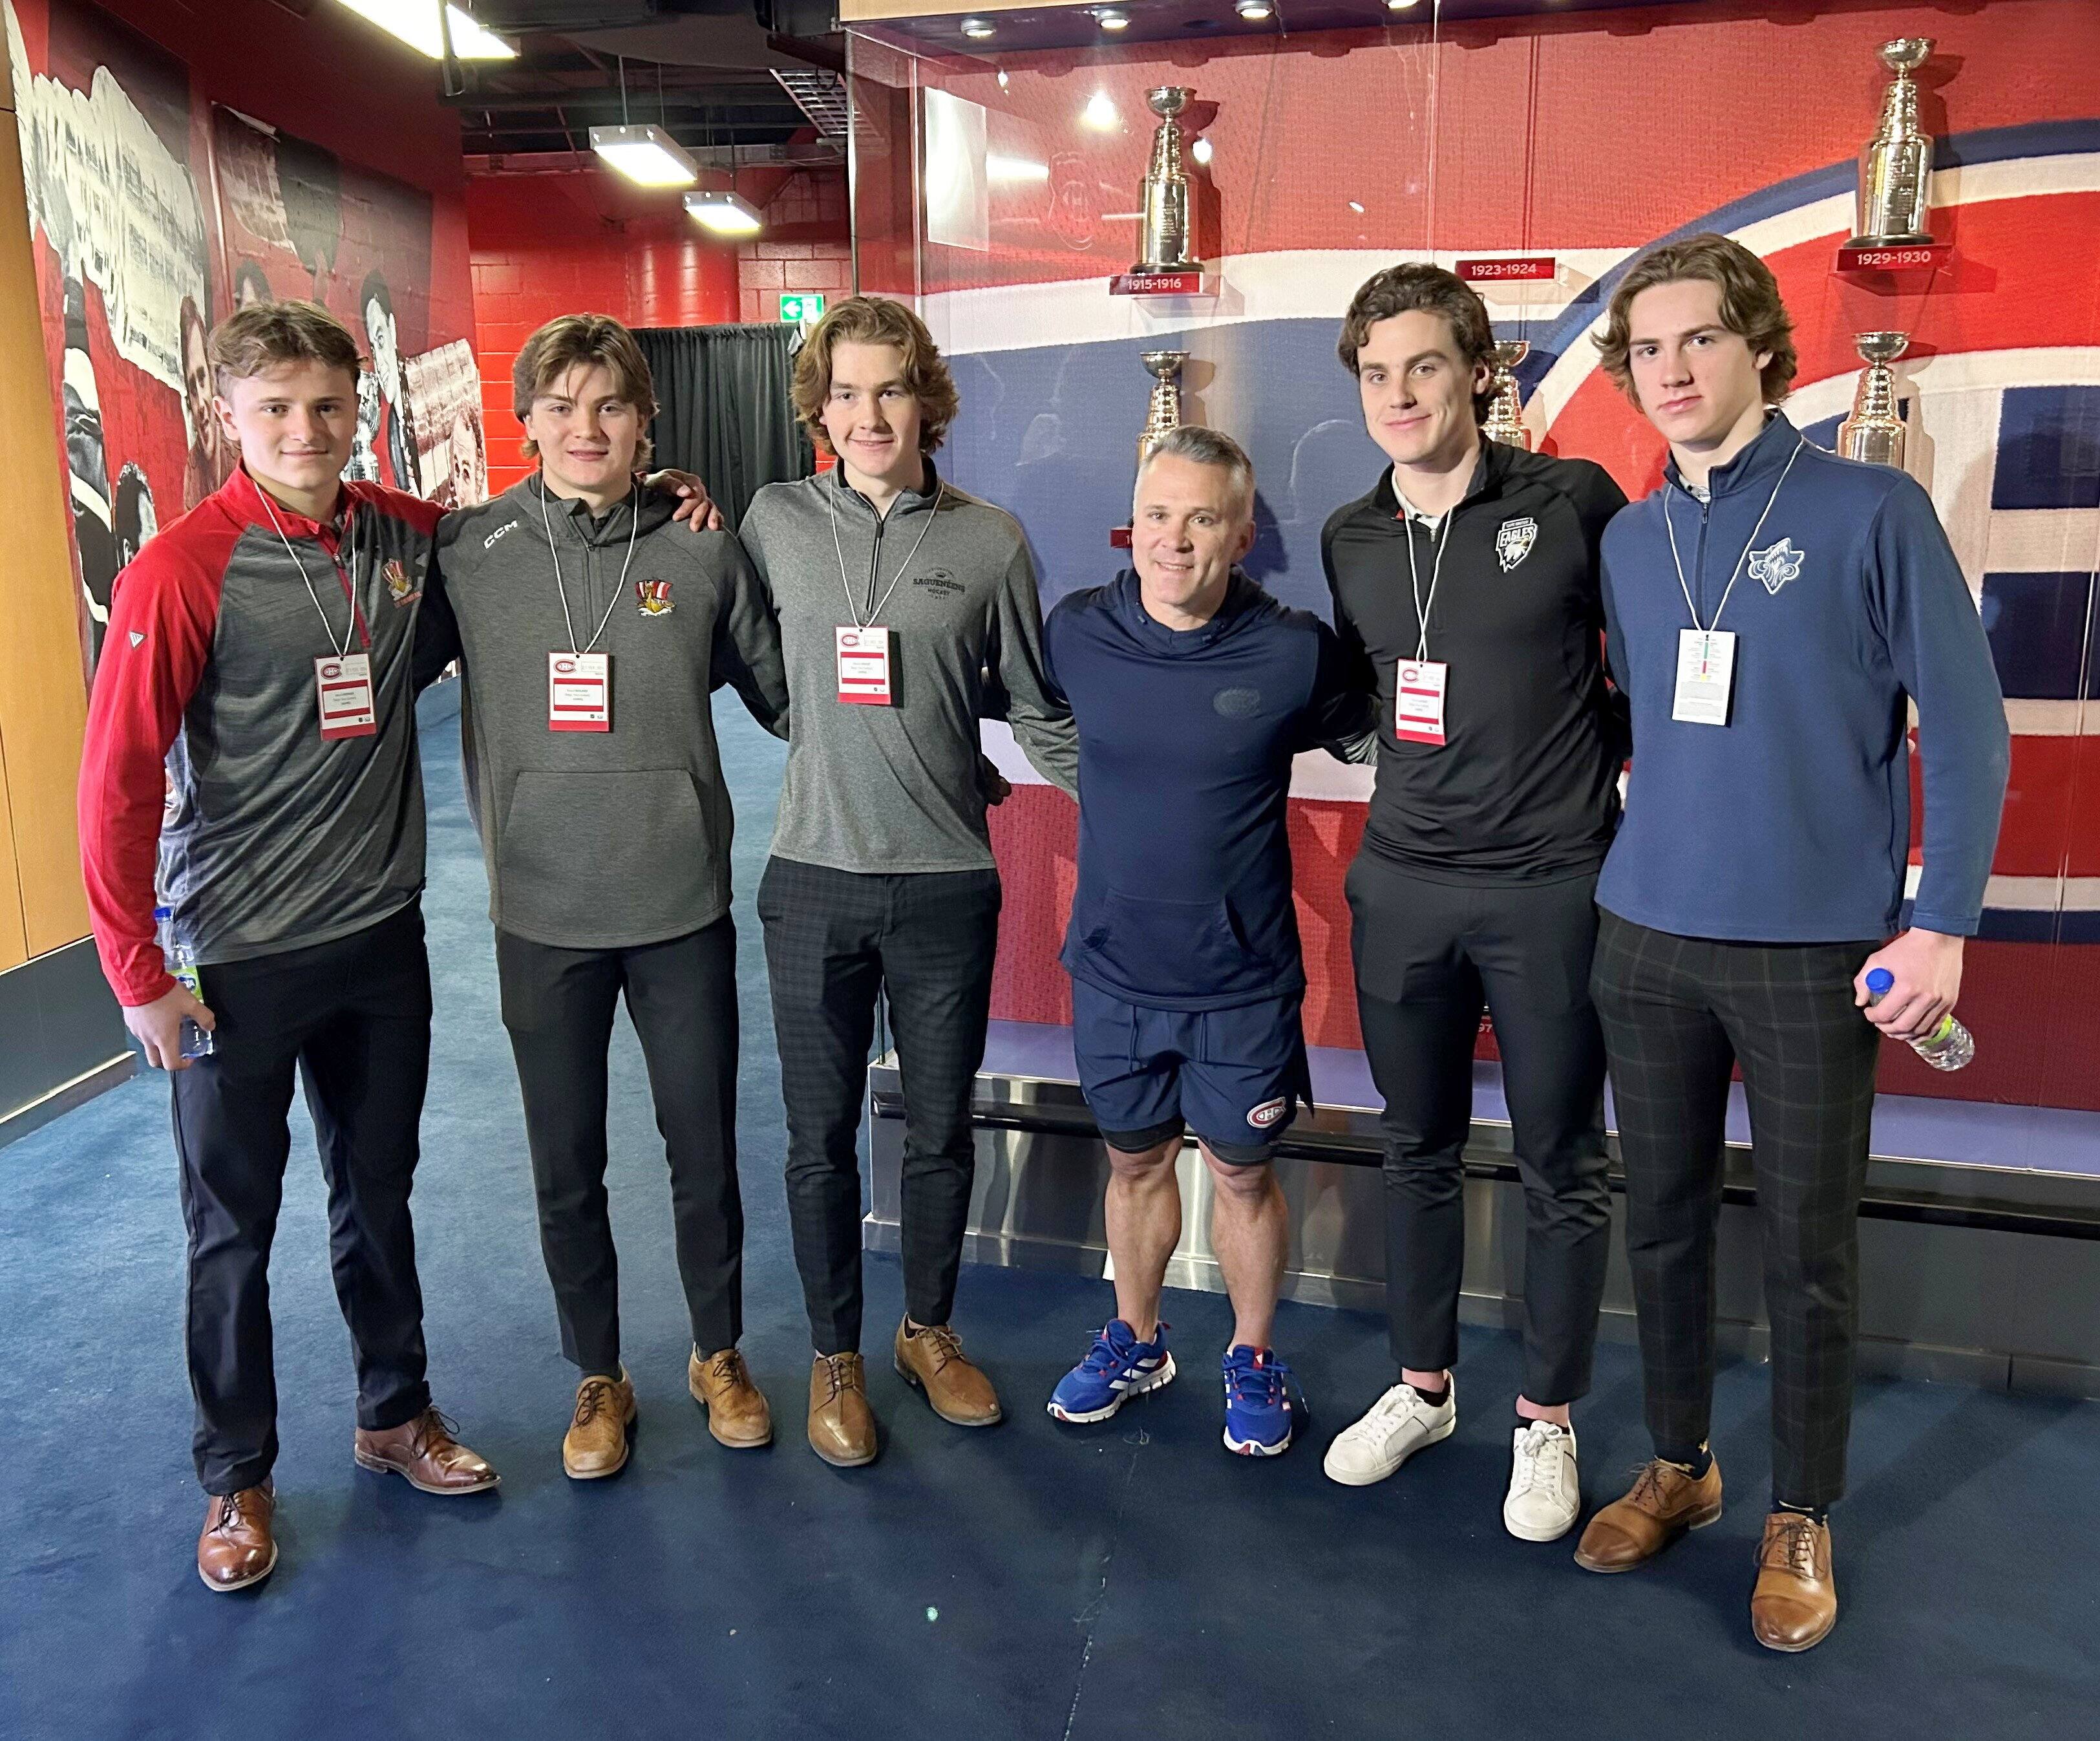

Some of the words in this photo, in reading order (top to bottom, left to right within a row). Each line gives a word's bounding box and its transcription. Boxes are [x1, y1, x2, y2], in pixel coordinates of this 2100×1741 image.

[1857, 251, 1931, 265] 1929-1930
[1471, 263, 1537, 276] 1923-1924
[1128, 278, 1182, 290] 1915-1916
[484, 520, 518, 549] CCM
[1500, 526, 1534, 548] EAGLES
